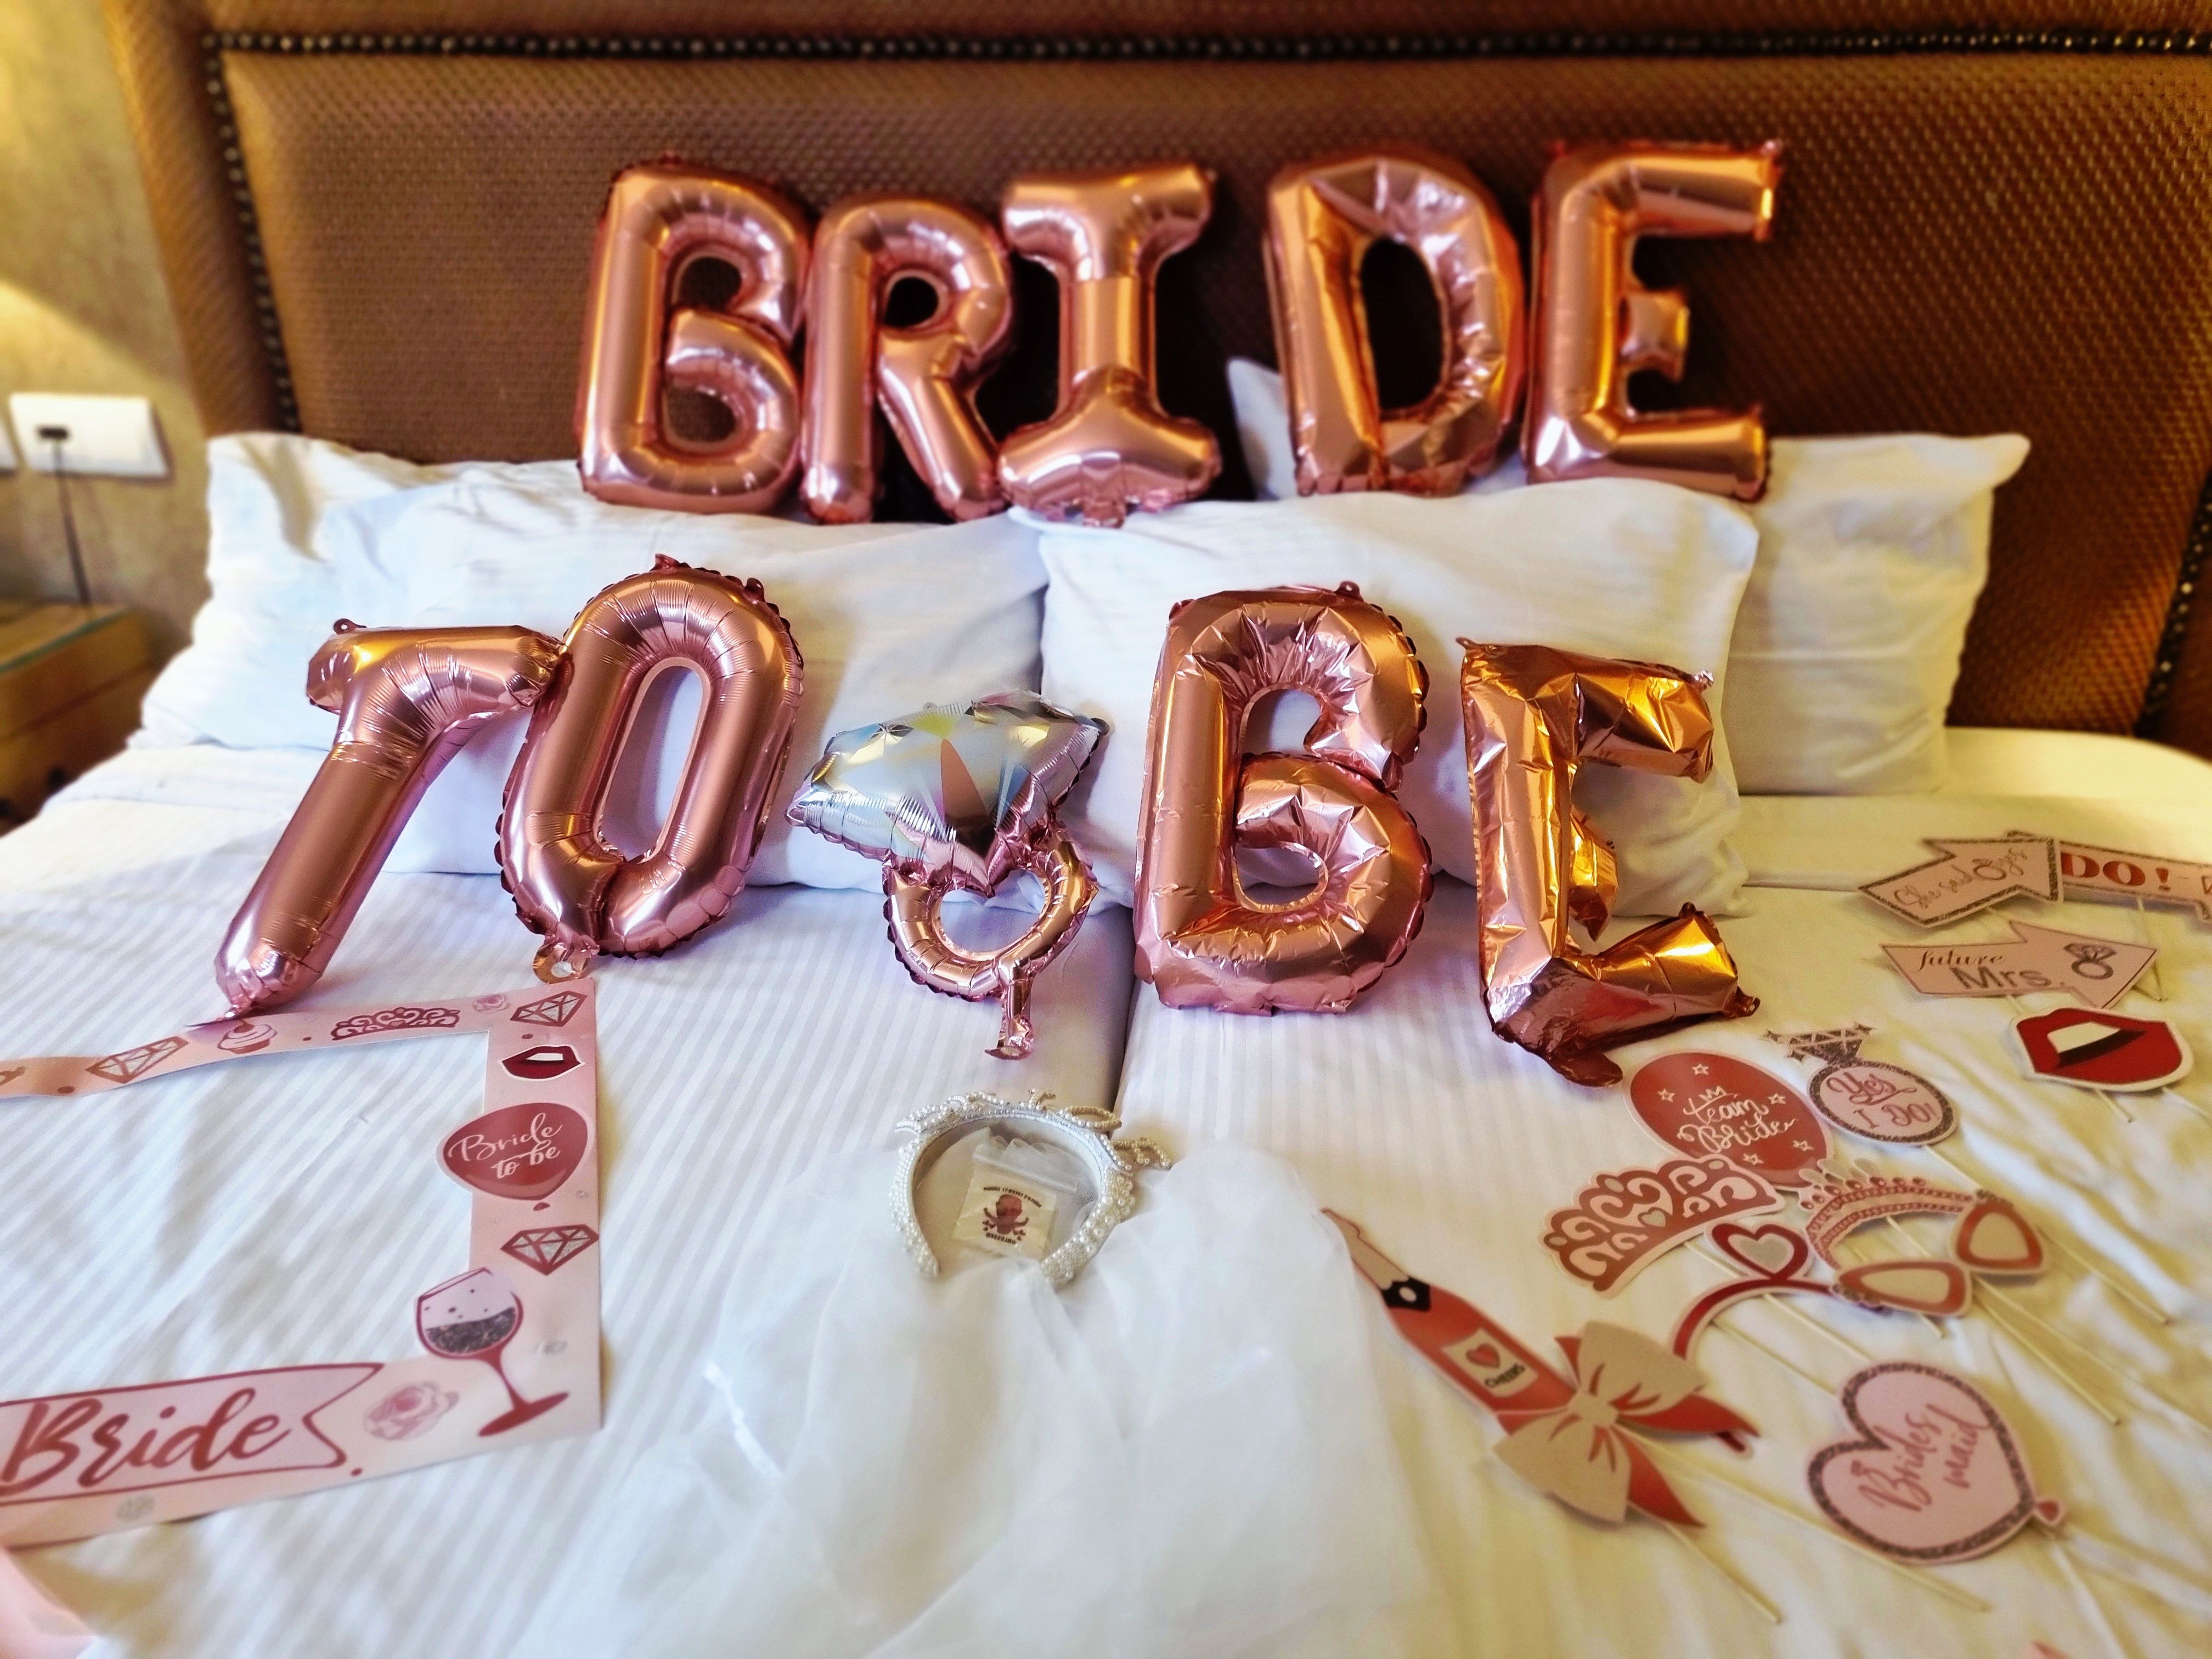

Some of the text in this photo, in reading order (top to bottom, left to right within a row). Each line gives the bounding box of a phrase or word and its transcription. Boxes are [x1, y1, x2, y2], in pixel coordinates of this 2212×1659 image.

[576, 140, 1783, 527] BRIDE
[1133, 582, 1760, 1086] BE
[2061, 851, 2171, 891] DO!
[1917, 950, 2004, 972] future
[1949, 966, 2066, 989] Mrs.
[1826, 1071, 1918, 1106] Yes
[448, 1112, 563, 1161] Bride
[1676, 1111, 1799, 1154] Bride
[1853, 1108, 1881, 1130] I
[490, 1140, 561, 1179] to be
[0, 1387, 292, 1497] Bride
